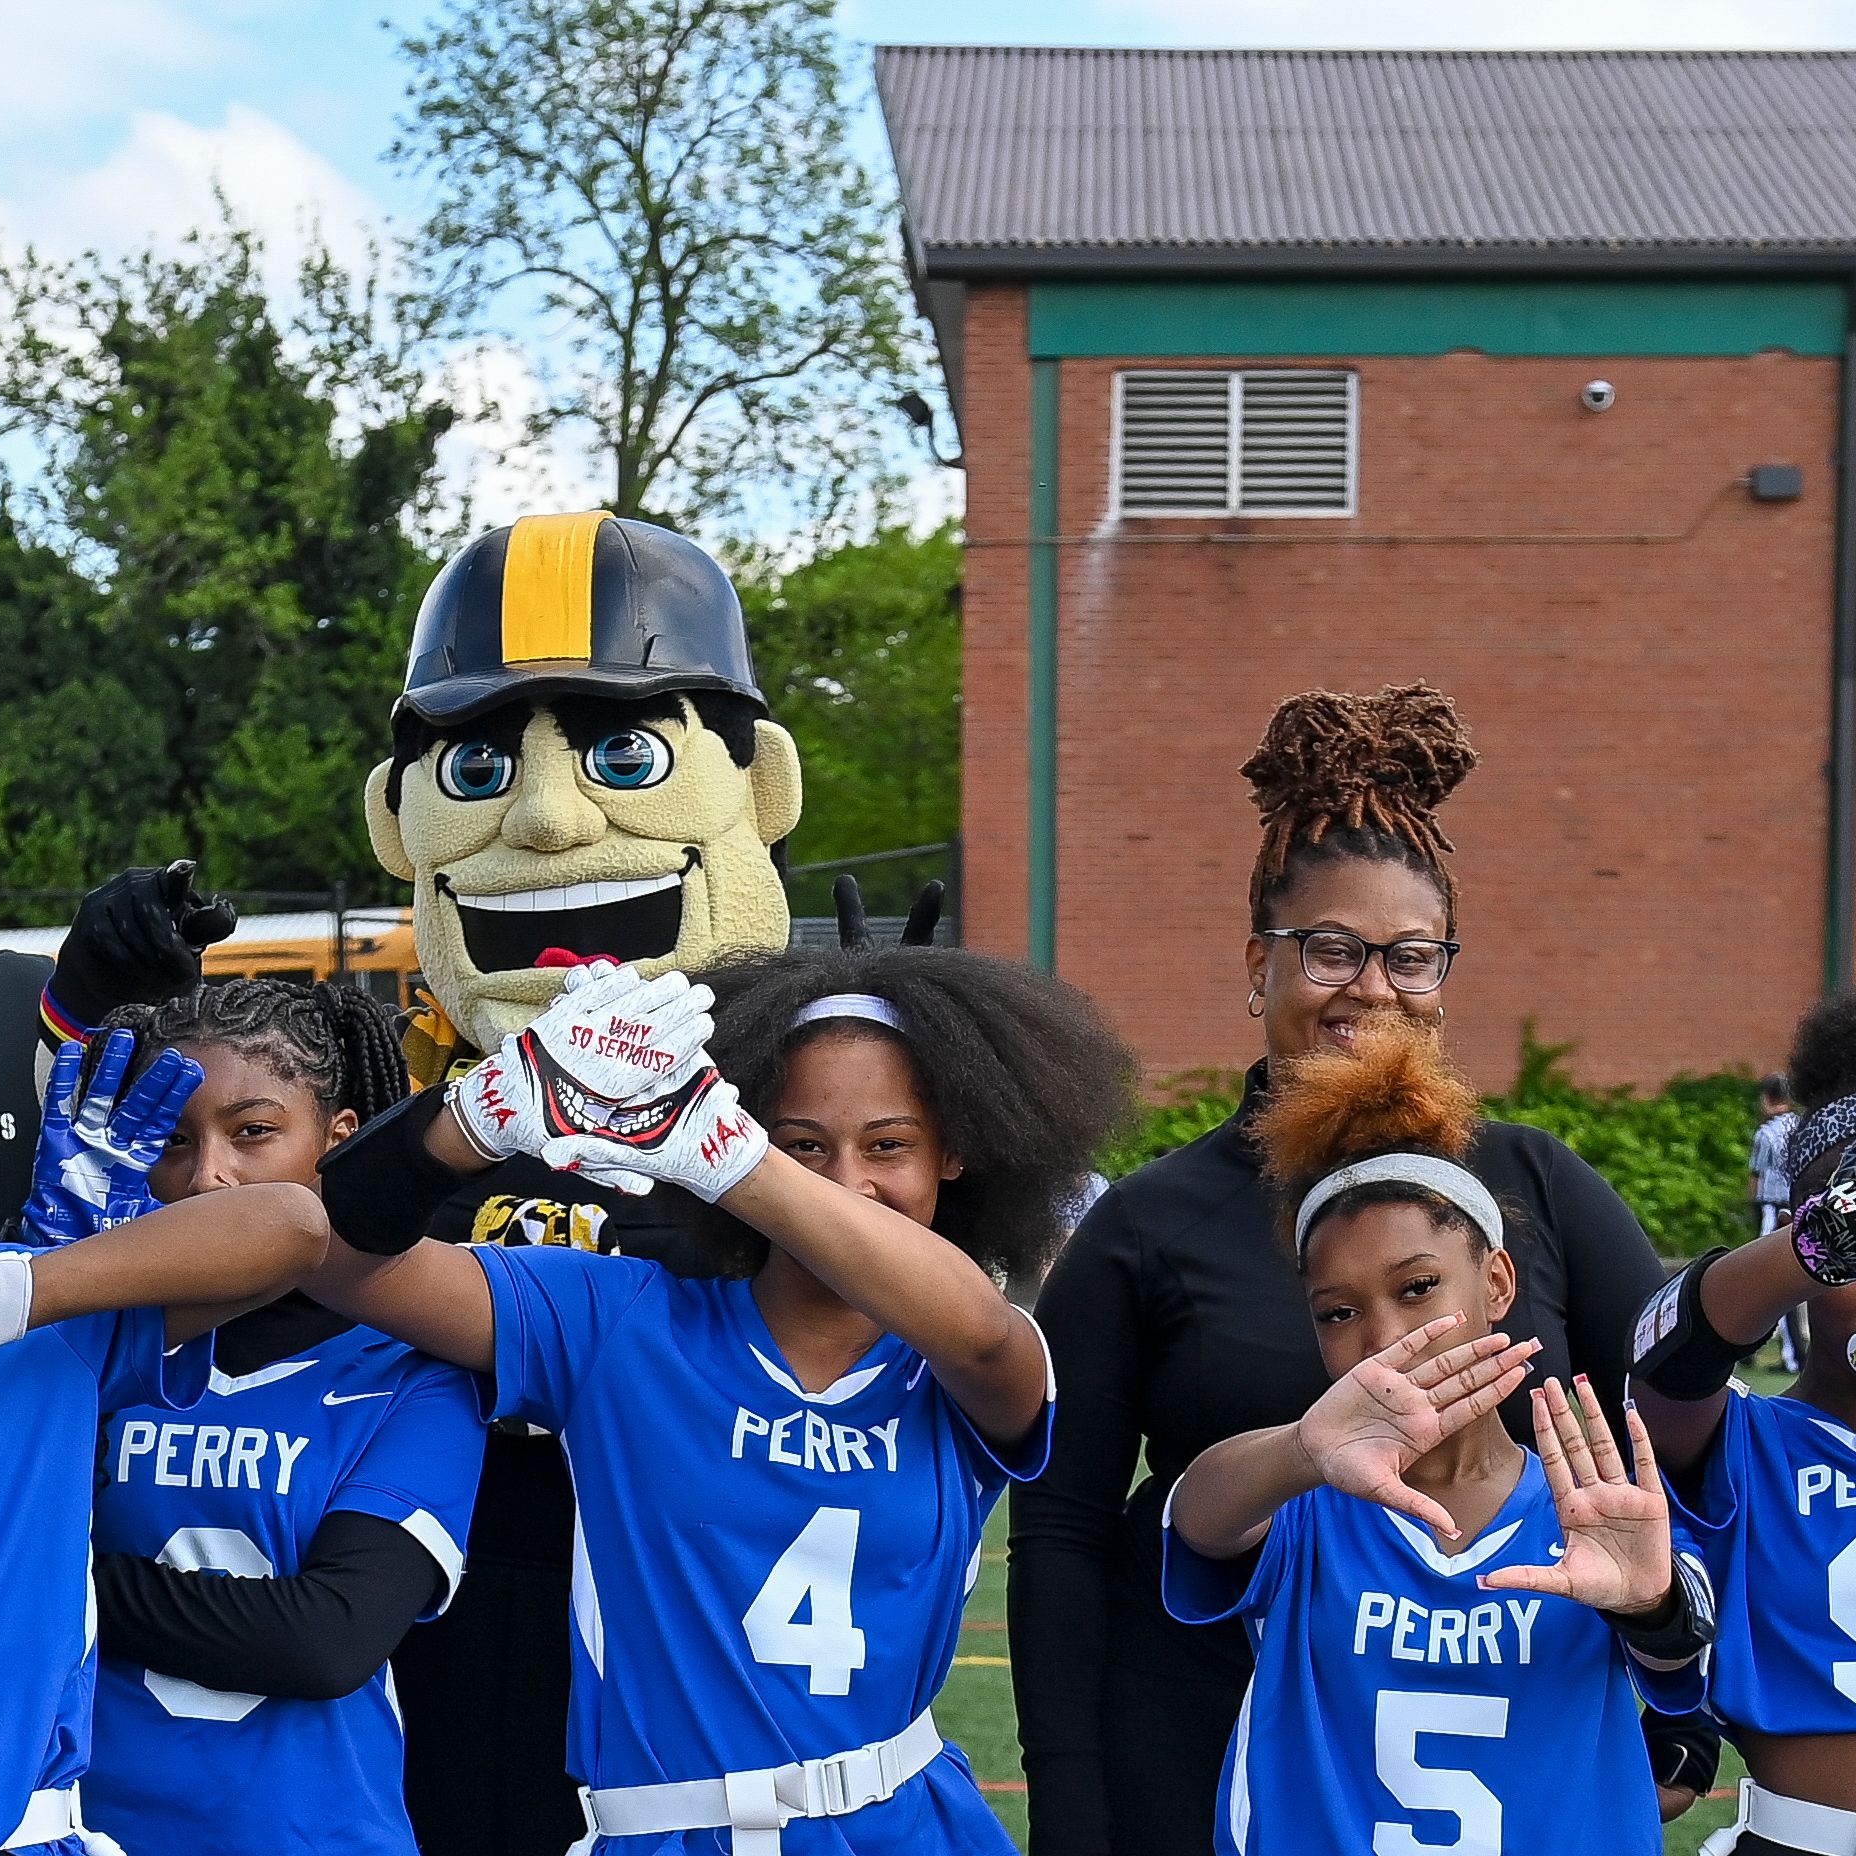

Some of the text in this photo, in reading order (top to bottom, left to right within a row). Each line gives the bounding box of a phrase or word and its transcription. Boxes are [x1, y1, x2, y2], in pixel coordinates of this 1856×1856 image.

[569, 1025, 674, 1075] SO SERIOUS?
[610, 1016, 653, 1042] WHY
[117, 1421, 310, 1495] PERRY
[731, 1405, 900, 1473] PERRY
[741, 1506, 866, 1696] 4
[1353, 1591, 1542, 1665] PERRY
